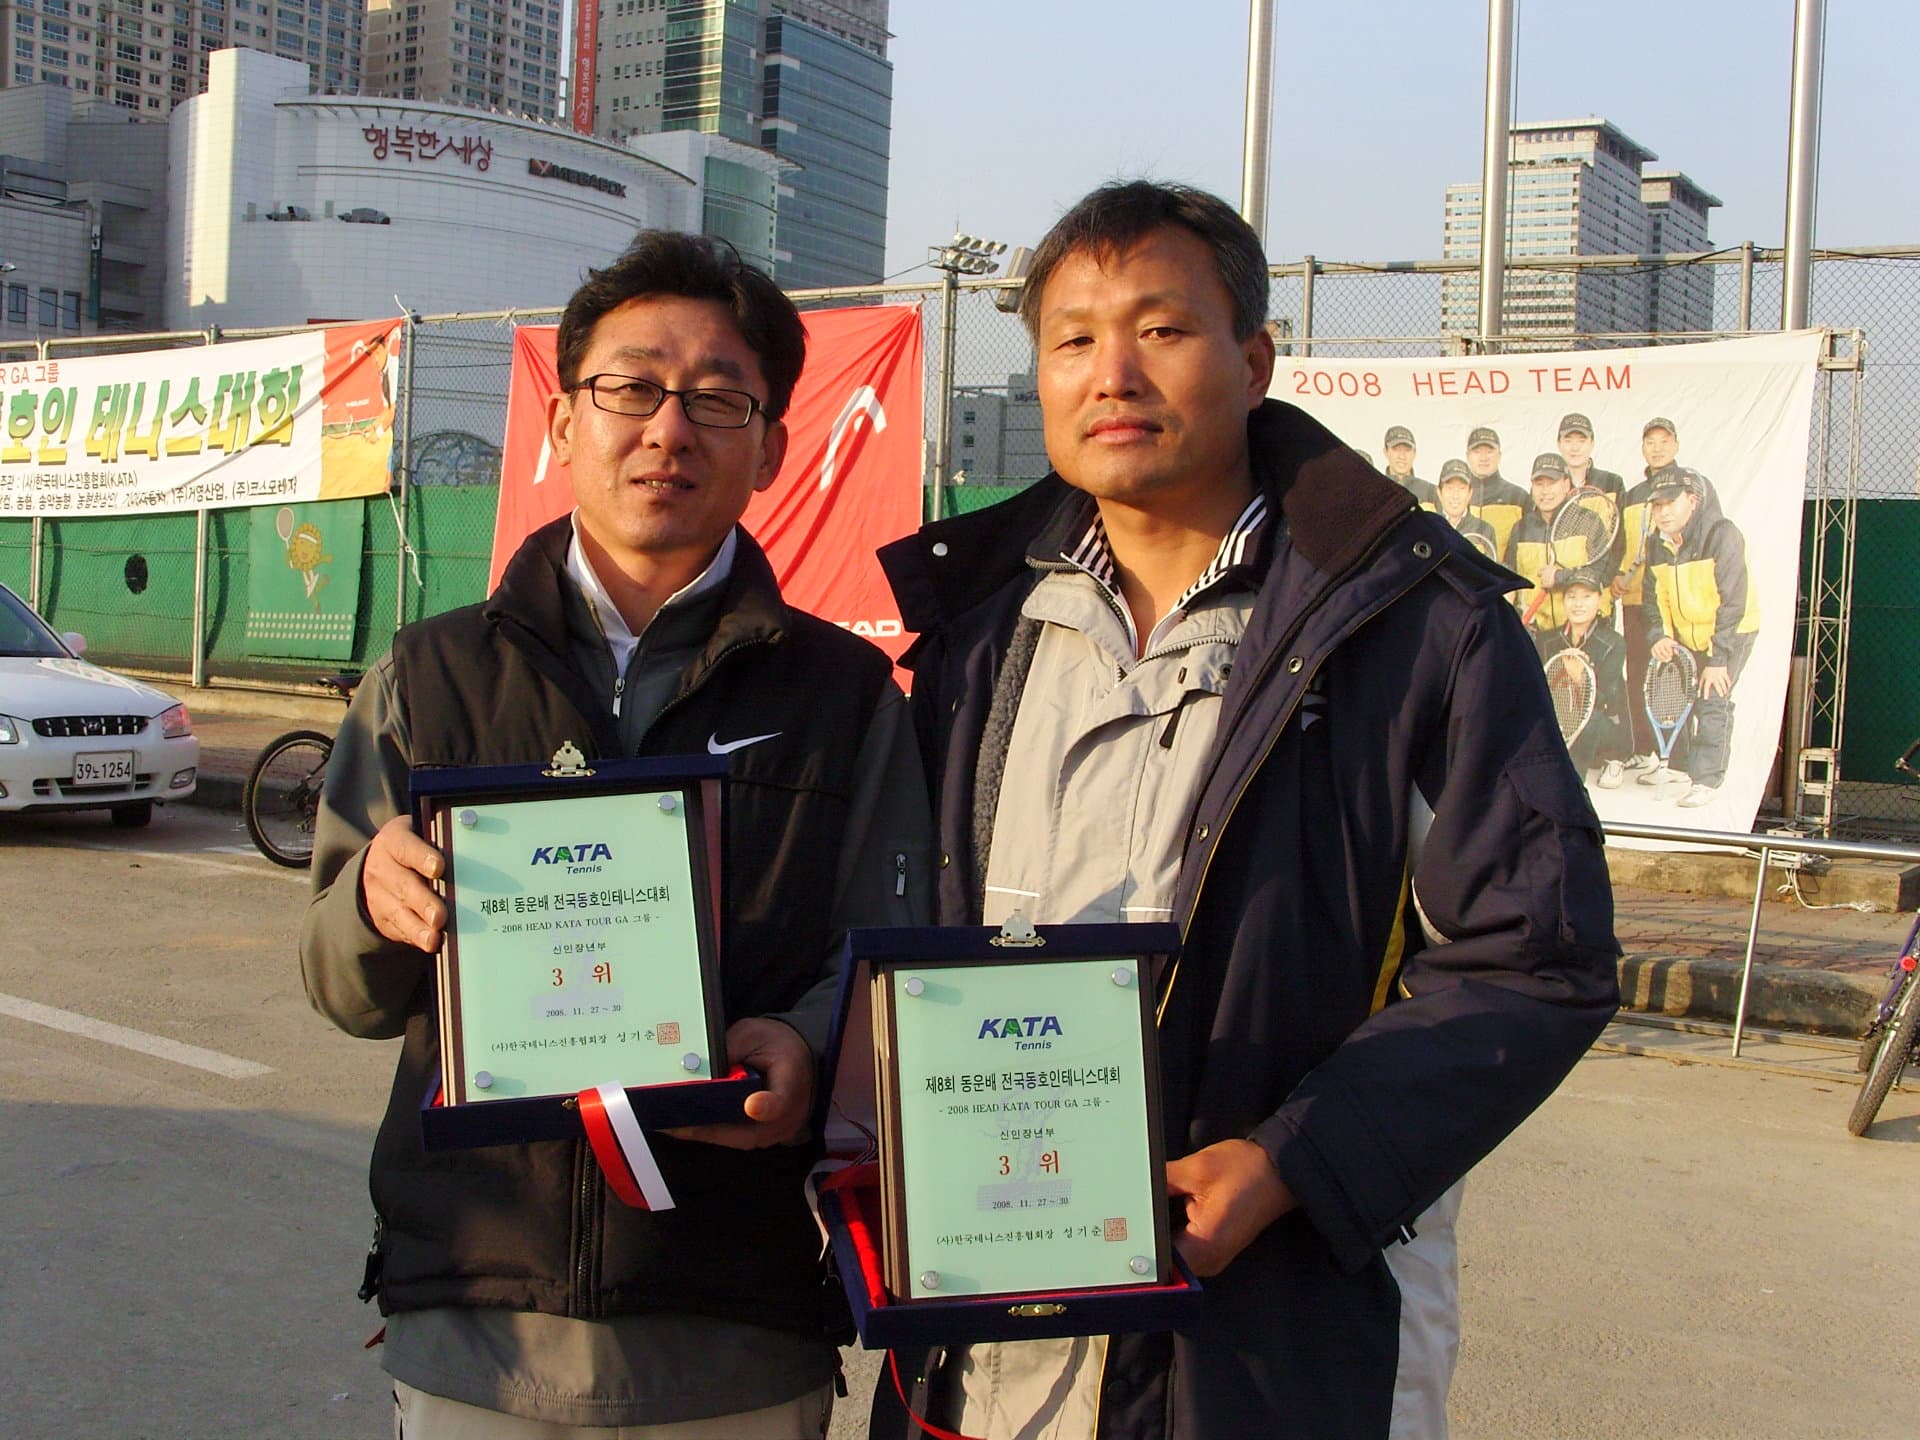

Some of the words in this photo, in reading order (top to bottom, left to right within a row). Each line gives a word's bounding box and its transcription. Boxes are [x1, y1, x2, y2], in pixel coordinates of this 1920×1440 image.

[362, 123, 494, 173] 행복한세상
[10, 366, 30, 385] GA
[34, 363, 59, 384] 그룹
[1293, 371, 1382, 397] 2008
[1412, 370, 1510, 397] HEAD
[1528, 365, 1632, 393] TEAM
[0, 387, 78, 466] 호인
[85, 365, 303, 464] 테니스대회
[77, 762, 131, 779] 39노1254
[531, 843, 613, 865] KATA
[567, 865, 602, 874] Tennis
[480, 898, 510, 916] 제8회
[514, 894, 549, 913] 동운배
[554, 885, 670, 911] 전국동호인테니스대회
[502, 924, 522, 933] 2008
[526, 922, 551, 932] HEAD
[555, 920, 582, 929] KATA
[587, 917, 612, 927] TOUR
[615, 916, 628, 924] GA
[552, 942, 607, 955] 신인장년부
[552, 968, 563, 986] 3
[592, 962, 611, 984] 위
[631, 1030, 640, 1041] 기
[978, 1016, 1063, 1039] KATA
[1014, 1040, 1052, 1050] Tennis
[926, 1074, 955, 1094] 제8회
[960, 1072, 997, 1092] 동운배
[1001, 1066, 1121, 1091] 전국동호인테니스대회
[947, 1105, 969, 1115] 2008
[972, 1103, 999, 1113] HEAD
[1003, 1102, 1030, 1112] KATA
[1034, 1100, 1060, 1110] TOUR
[1064, 1098, 1078, 1108] GA
[1000, 1127, 1056, 1140] 신인장년부
[999, 1155, 1010, 1176] 3
[1039, 1150, 1059, 1174] 위
[1078, 1225, 1087, 1237] 기
